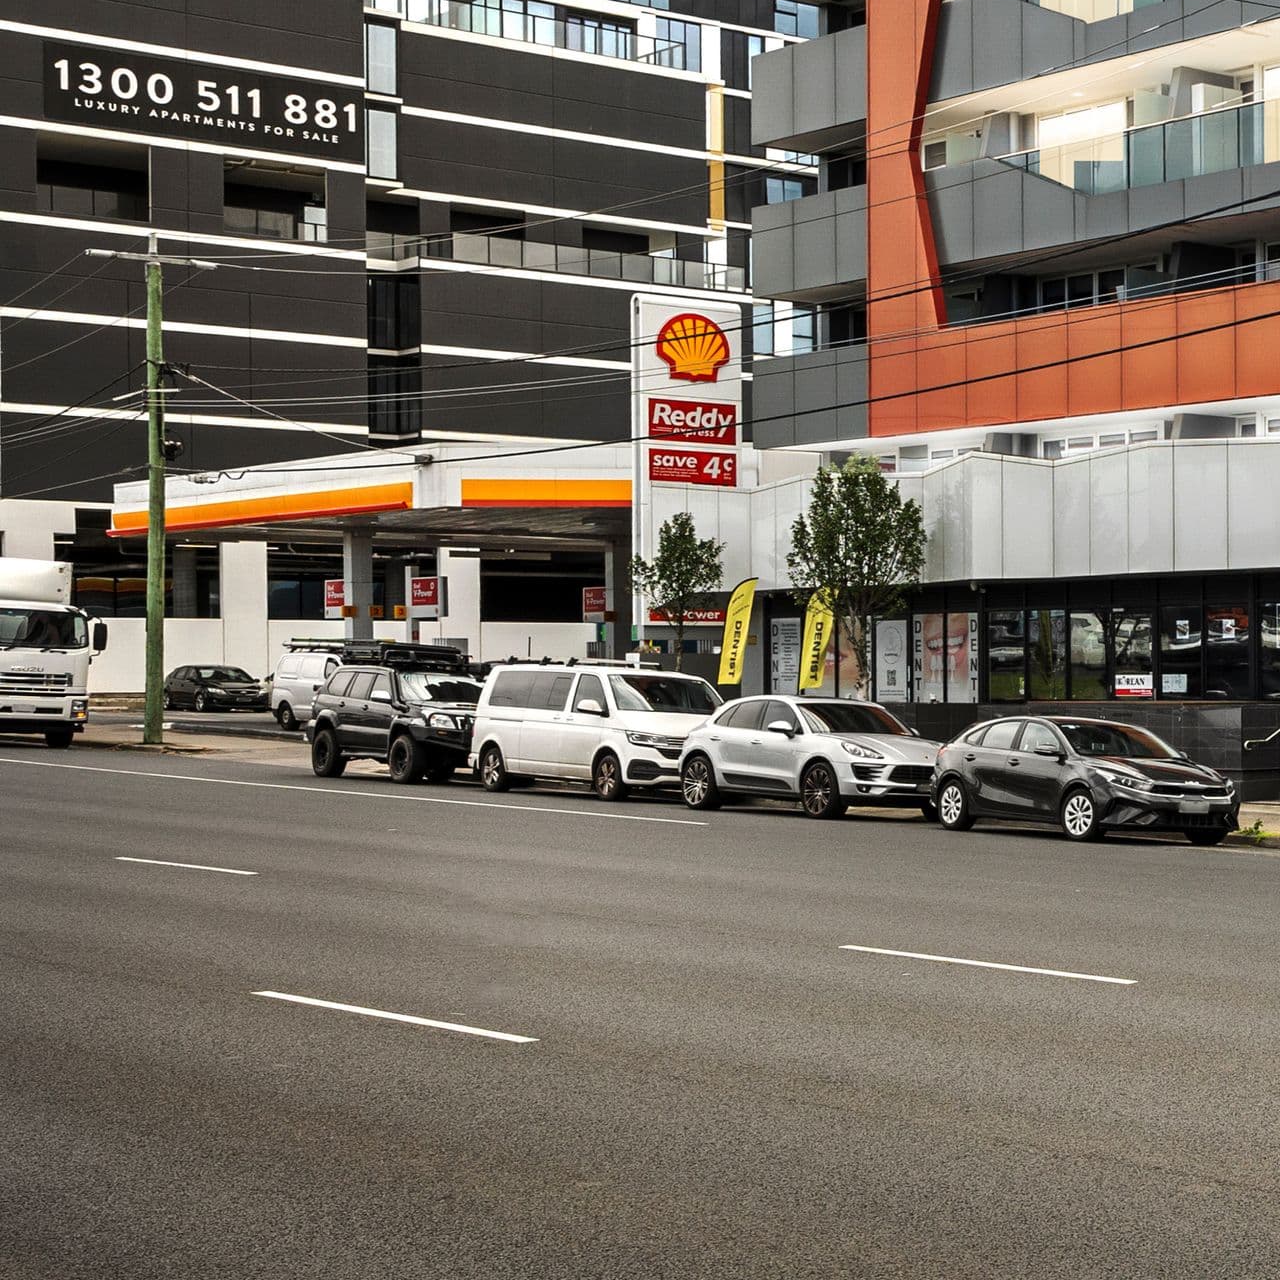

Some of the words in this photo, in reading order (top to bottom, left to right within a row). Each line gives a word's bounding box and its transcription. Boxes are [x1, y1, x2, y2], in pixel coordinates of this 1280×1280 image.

[54, 59, 174, 105] 1300
[196, 79, 261, 118] 511
[283, 93, 357, 133] 881
[74, 98, 141, 115] LUXURY
[149, 109, 256, 132] APARTMENTS
[264, 125, 295, 137] FOR
[302, 130, 339, 144] SALE
[652, 403, 733, 438] Reddy
[673, 427, 715, 438] express
[652, 454, 698, 468] save
[728, 620, 742, 678] DENTIST
[810, 622, 824, 681] DENTIST
